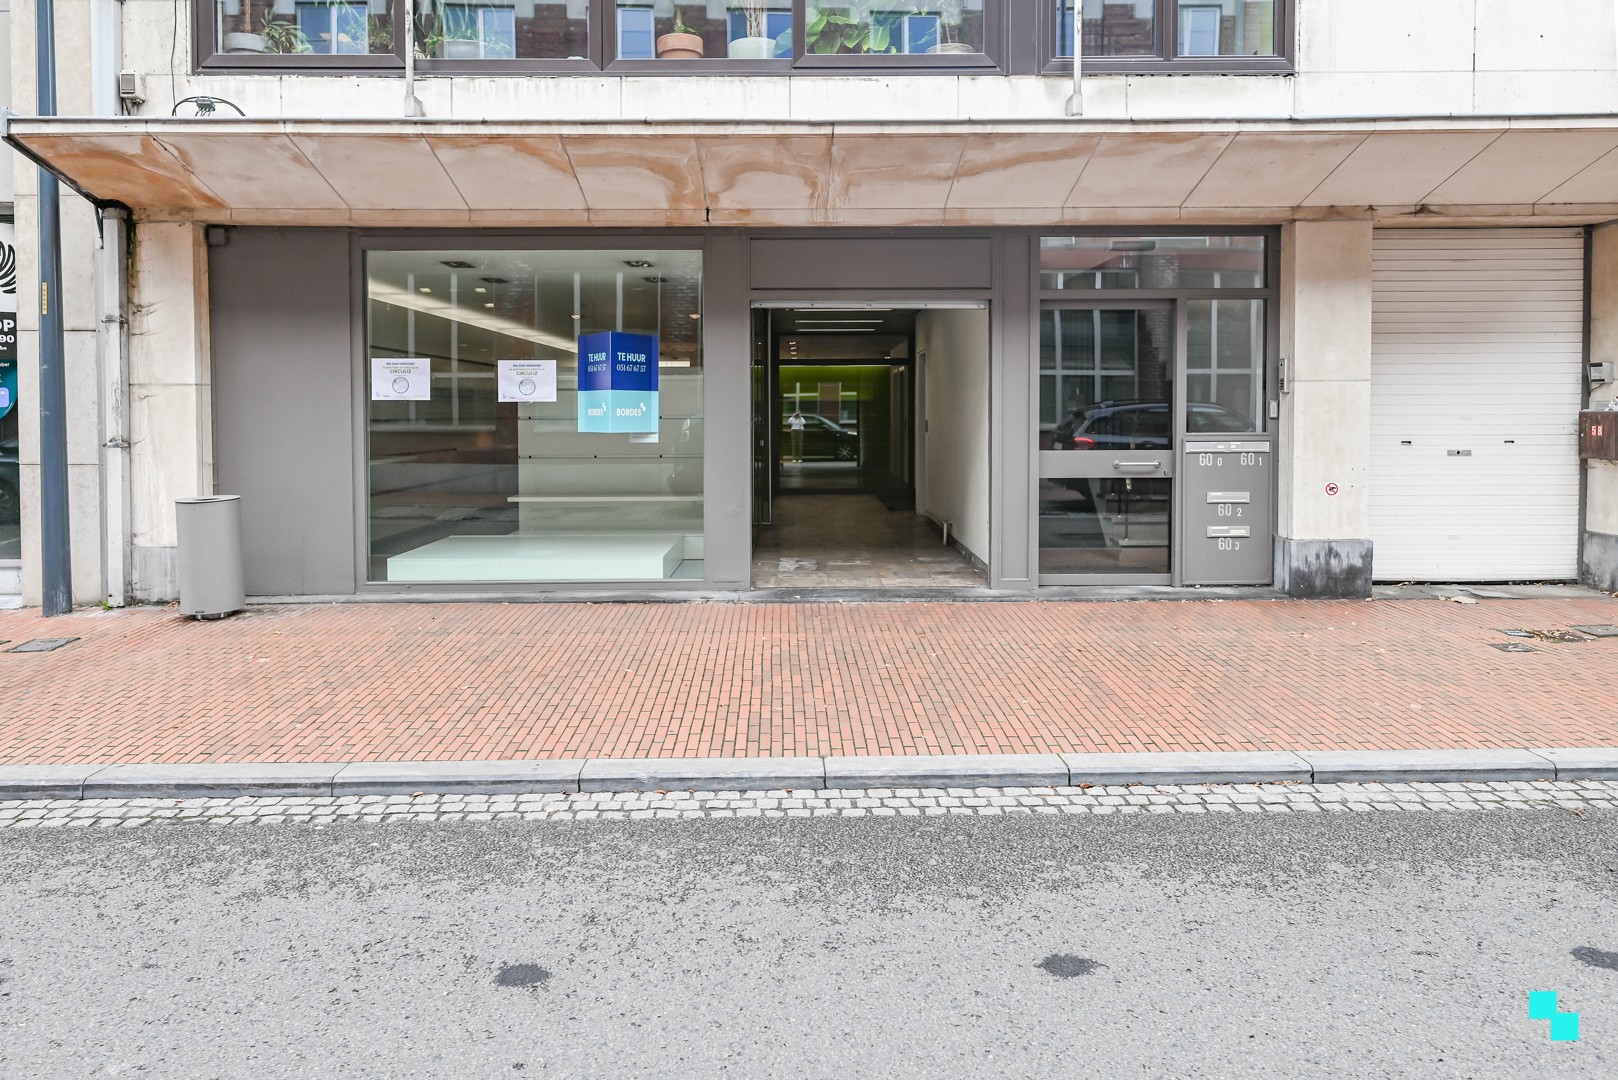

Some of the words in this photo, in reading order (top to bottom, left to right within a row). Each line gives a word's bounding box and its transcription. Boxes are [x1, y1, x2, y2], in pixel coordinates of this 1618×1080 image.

[0, 319, 15, 332] P
[588, 353, 594, 362] TE
[593, 352, 606, 362] HUUR
[617, 352, 625, 361] TE
[627, 353, 646, 362] HUUR
[617, 363, 625, 371] 051
[626, 364, 632, 372] 67
[633, 364, 639, 372] 67
[587, 408, 603, 416] BORDES
[616, 408, 642, 416] BORDES
[1591, 425, 1602, 436] 58
[1199, 453, 1213, 466] 60
[1217, 457, 1223, 466] 0
[1240, 452, 1255, 466] 60
[1258, 456, 1262, 466] 1
[1218, 503, 1232, 516] 60
[1236, 507, 1242, 517] 2
[1218, 537, 1232, 550] 60
[1234, 541, 1240, 550] 3
